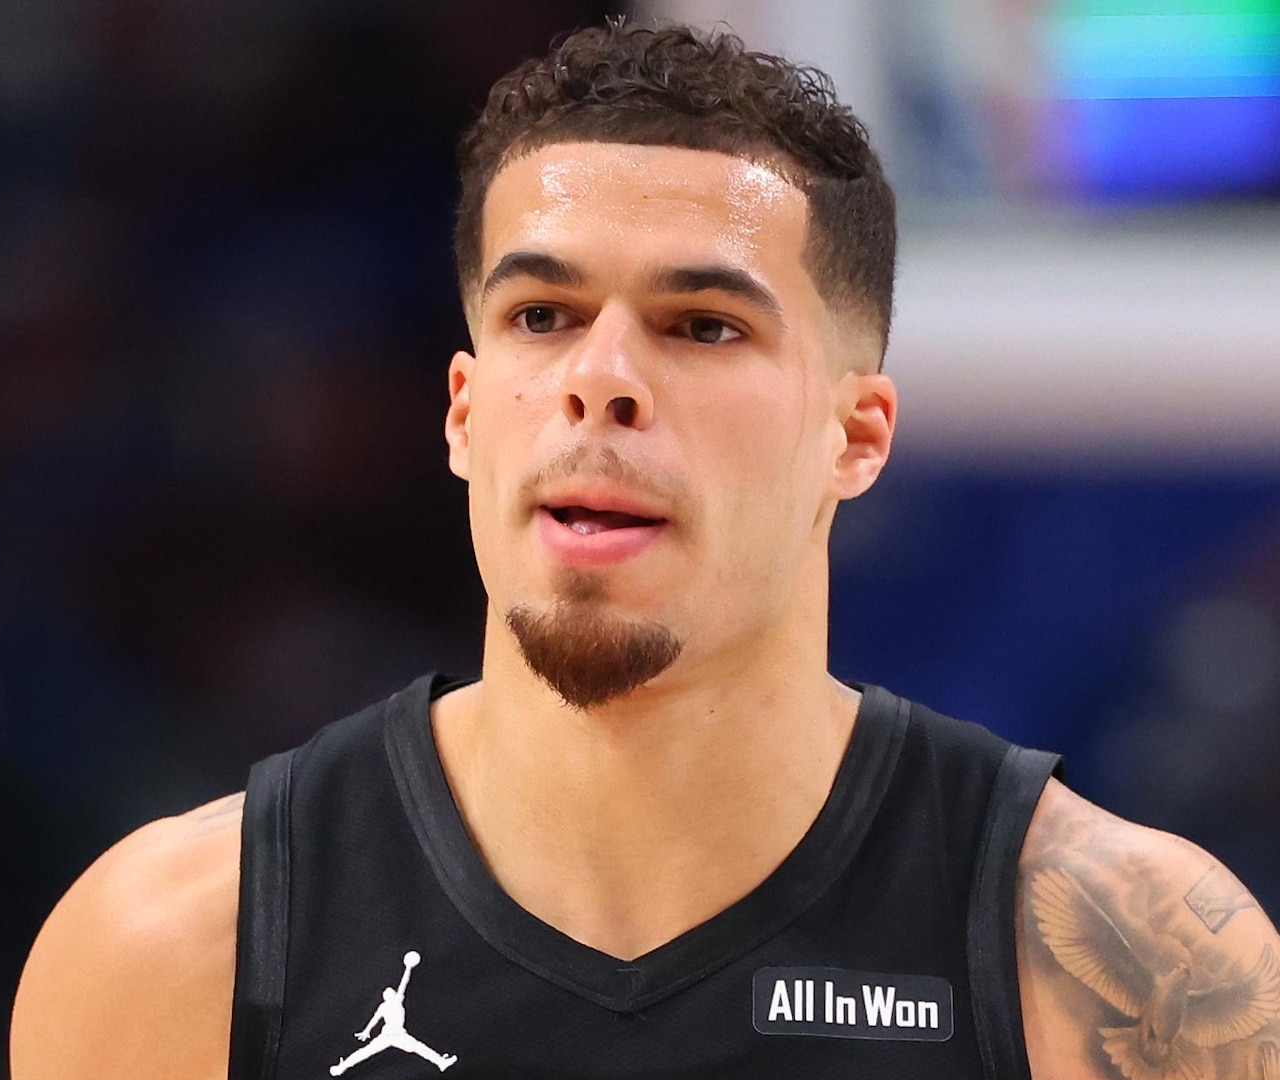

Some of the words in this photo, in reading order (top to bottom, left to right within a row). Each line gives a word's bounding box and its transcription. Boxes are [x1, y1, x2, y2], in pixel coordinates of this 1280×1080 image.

[768, 979, 814, 1021] All
[824, 981, 856, 1025] In
[862, 984, 939, 1029] Won
